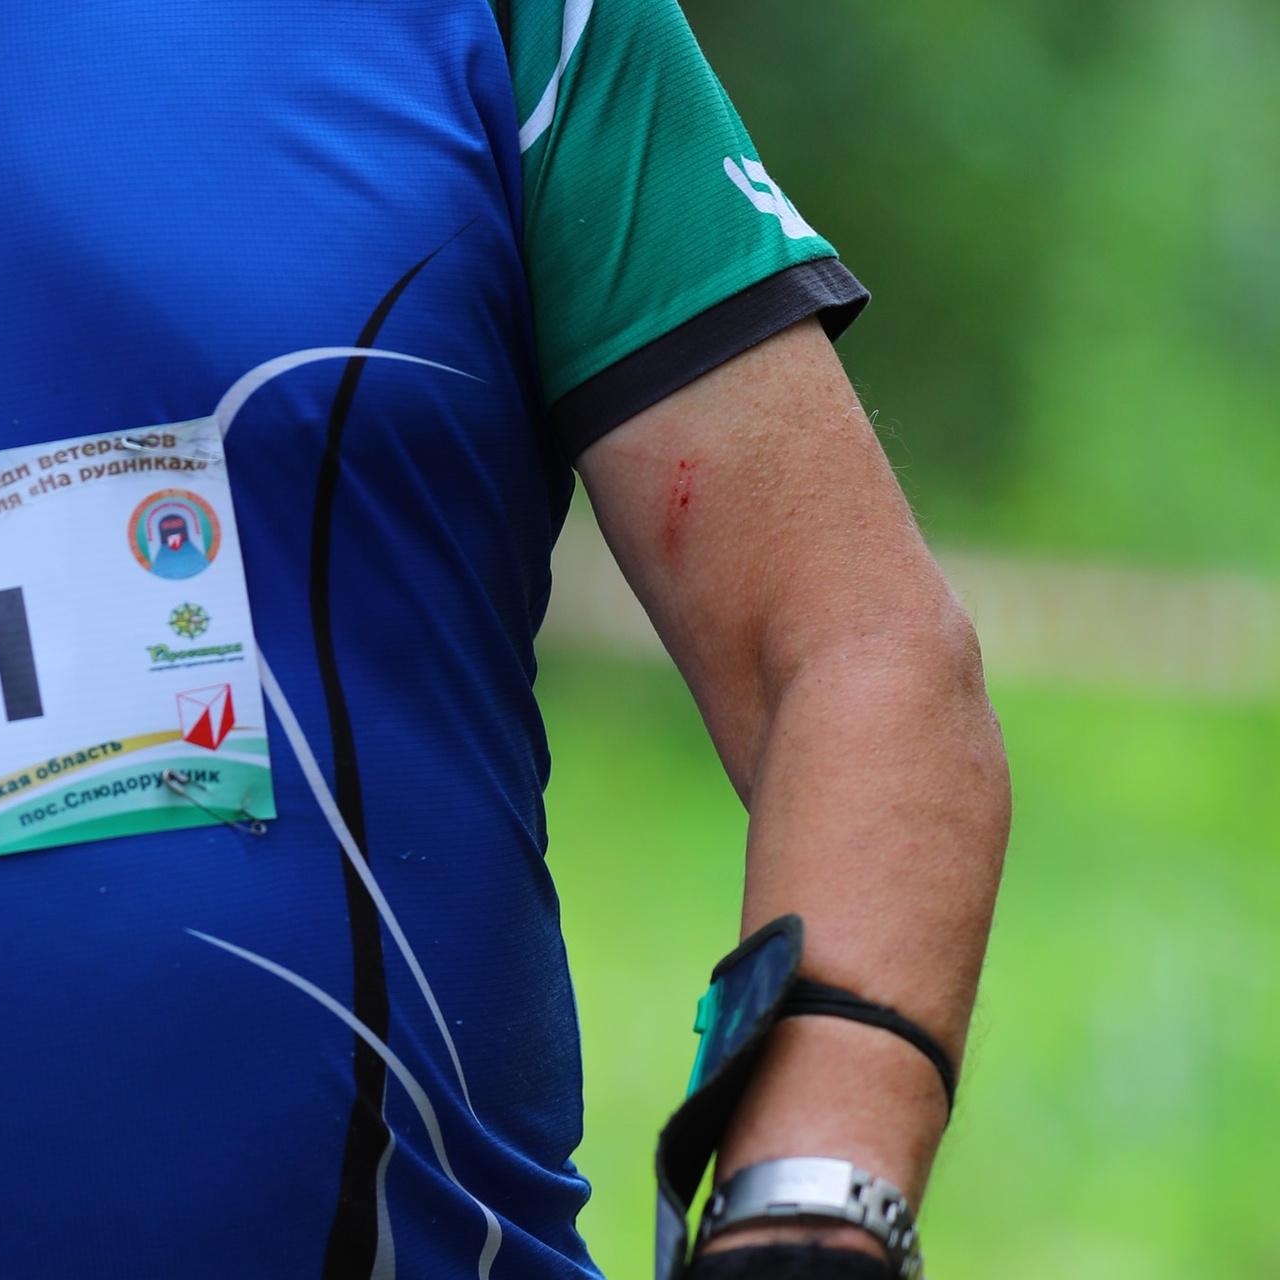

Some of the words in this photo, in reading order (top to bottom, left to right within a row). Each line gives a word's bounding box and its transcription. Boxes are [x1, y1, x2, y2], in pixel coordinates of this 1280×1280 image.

[38, 432, 176, 471] ветераов
[29, 472, 73, 498] «На
[78, 455, 208, 482] рудниках»
[36, 739, 123, 780] область
